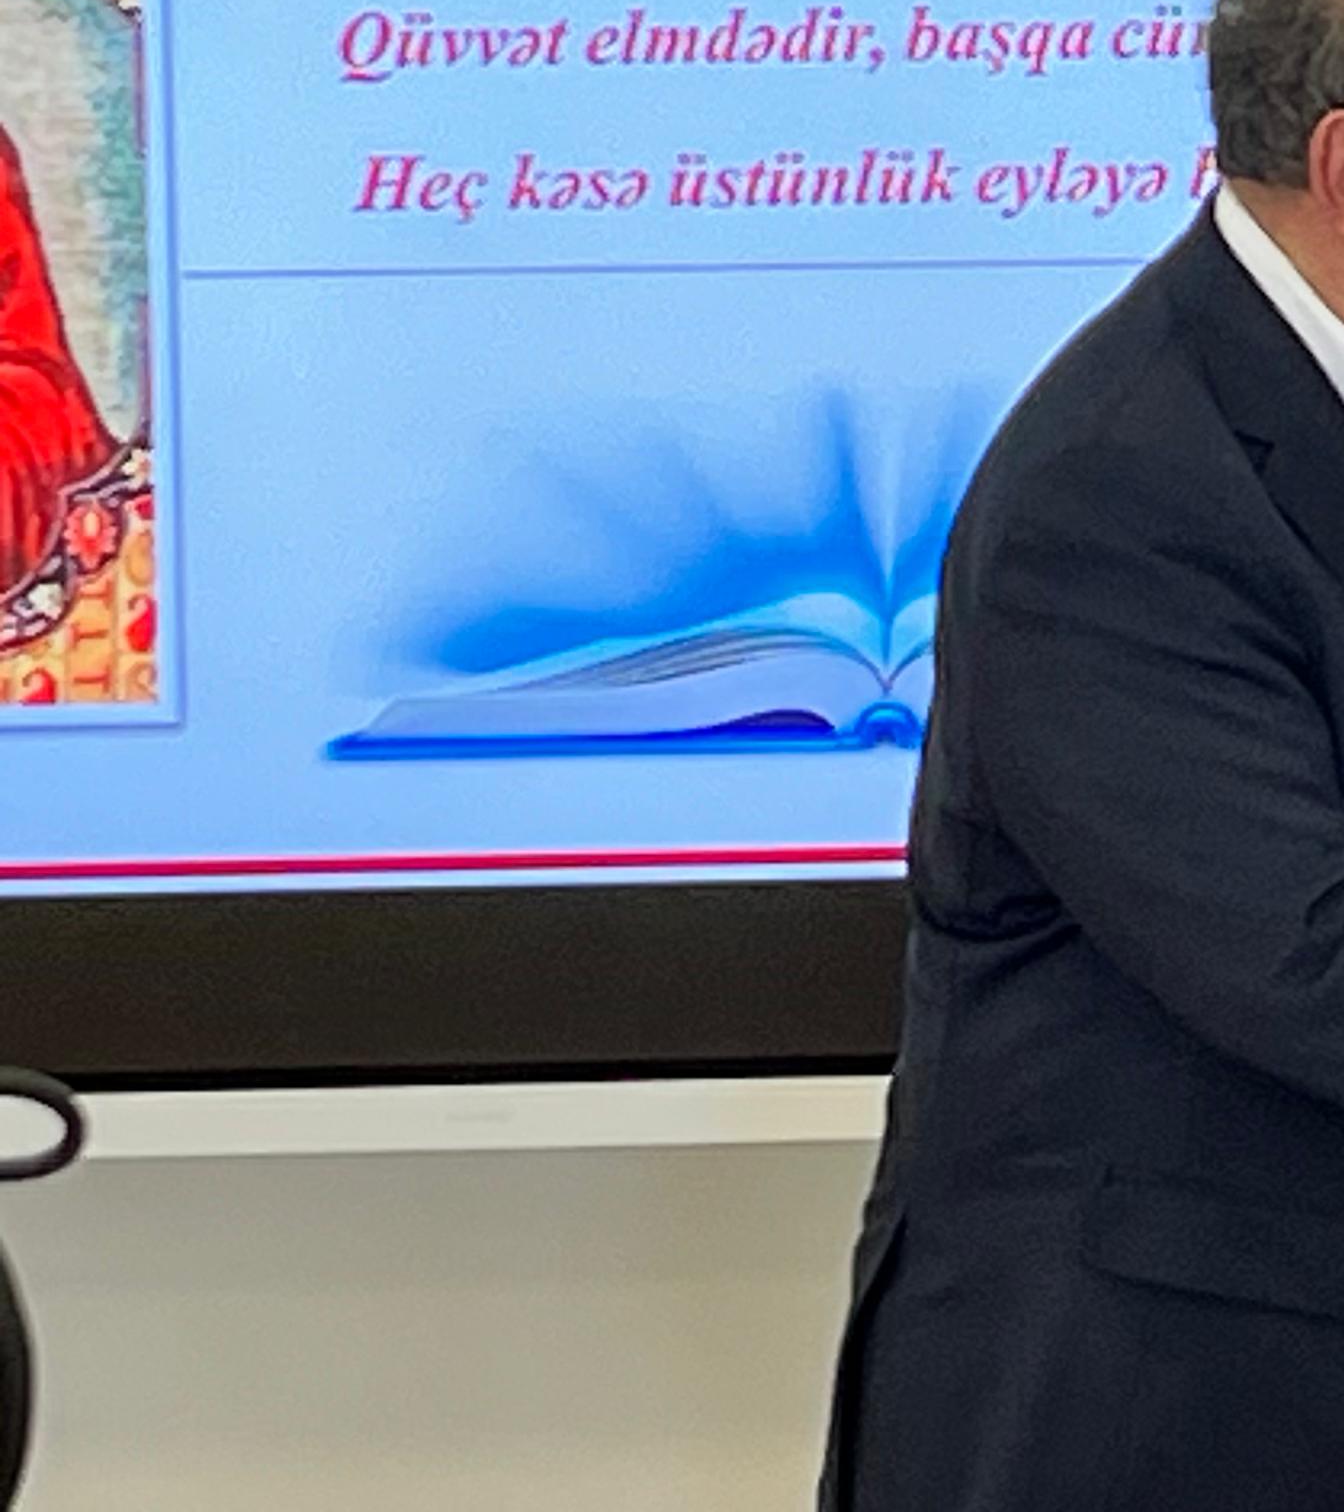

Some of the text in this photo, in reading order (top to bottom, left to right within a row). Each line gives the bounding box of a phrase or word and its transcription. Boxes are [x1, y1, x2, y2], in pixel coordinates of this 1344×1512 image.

[339, 10, 569, 83] Qüvvət
[585, 6, 886, 73] elmdədir,
[906, 5, 1095, 76] başqa
[353, 153, 489, 224] Heç
[508, 152, 649, 210] kəsə
[669, 148, 961, 209] üstünlük
[976, 146, 1169, 219] eyləyə
